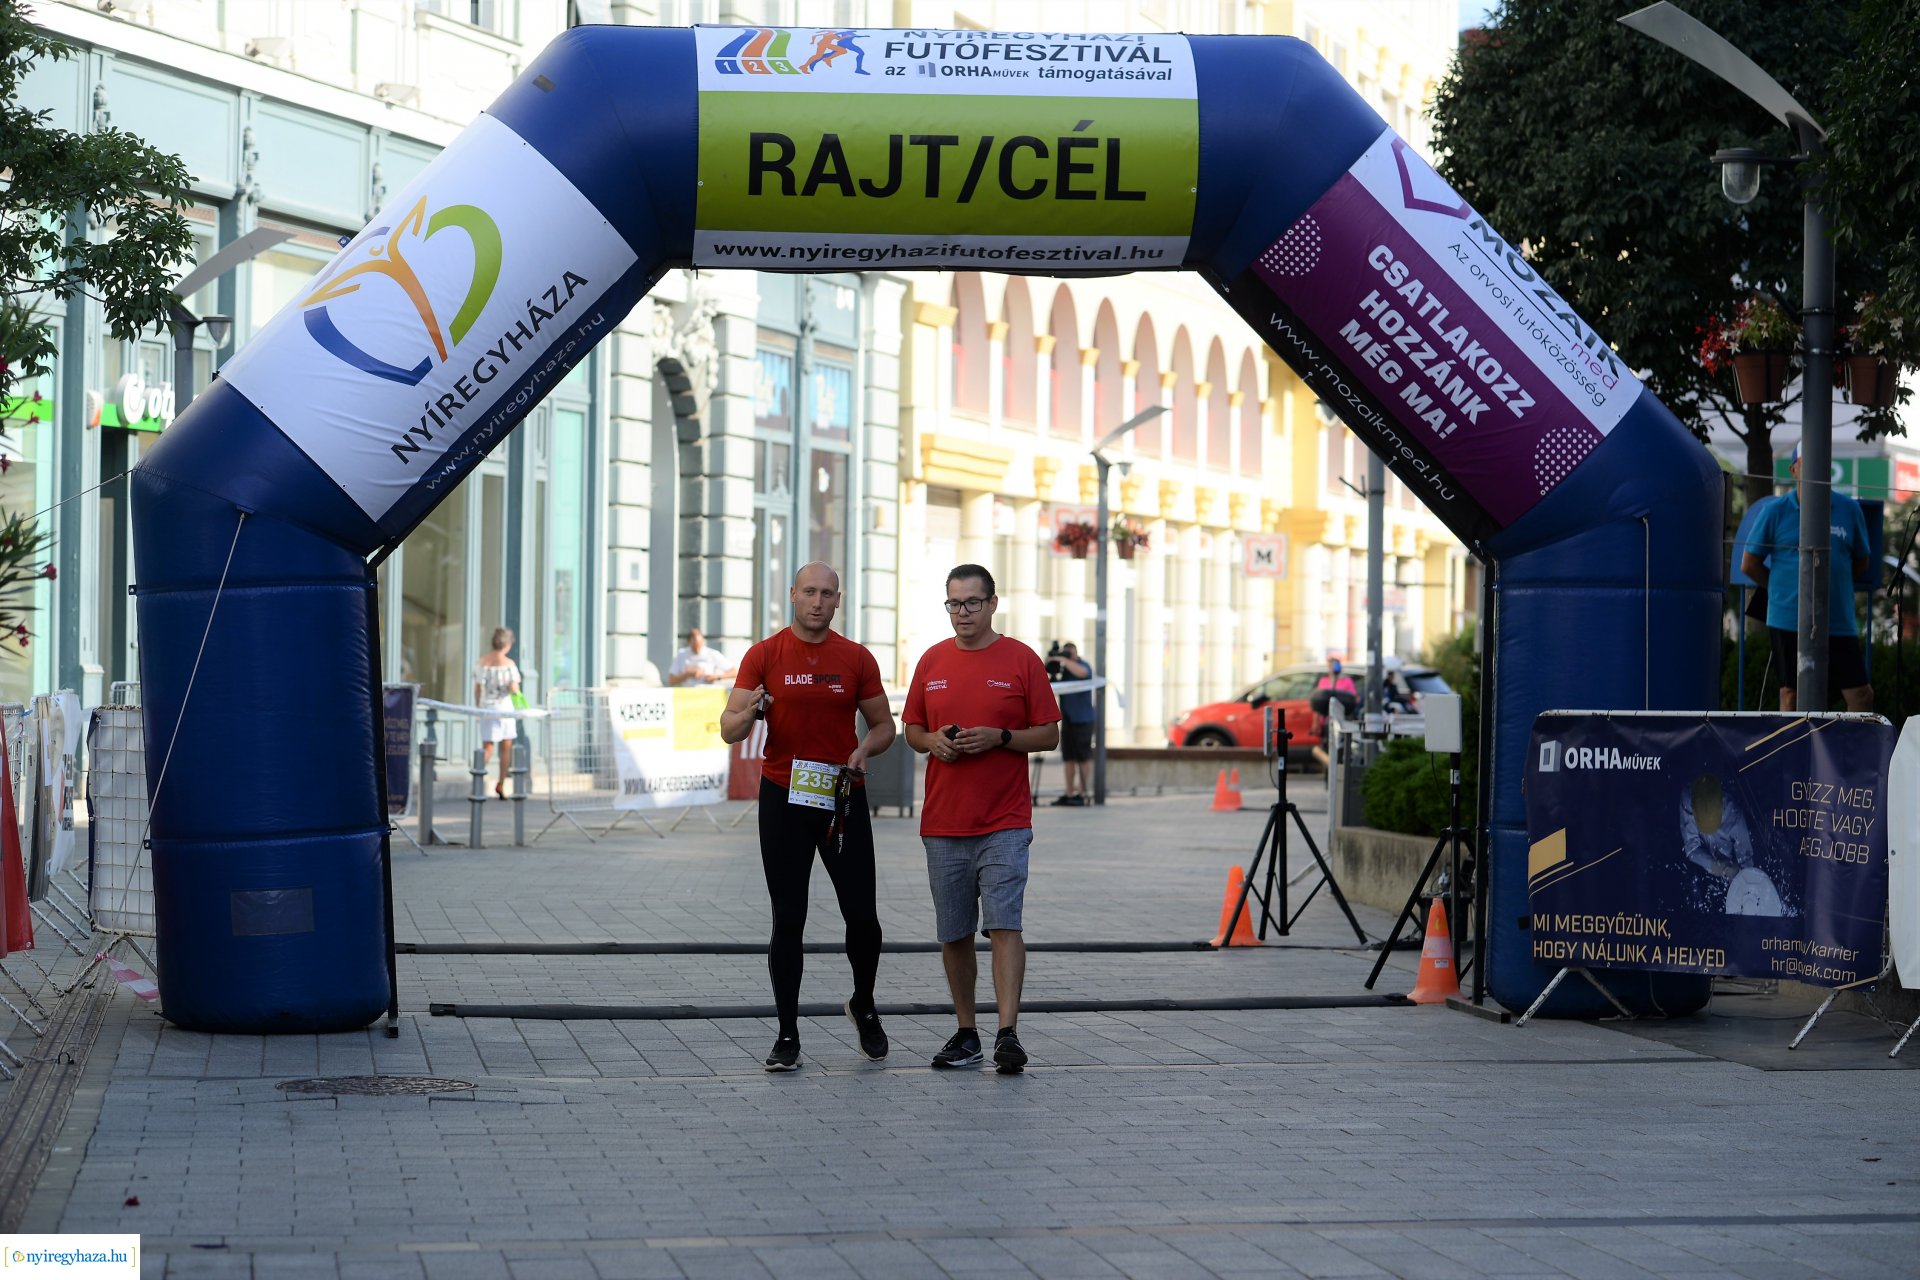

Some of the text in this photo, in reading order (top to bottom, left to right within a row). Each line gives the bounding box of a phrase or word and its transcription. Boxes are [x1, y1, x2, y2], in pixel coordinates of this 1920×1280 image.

[884, 39, 1172, 64] FUTÓFESZTIVÁL
[885, 66, 906, 76] az
[1038, 65, 1172, 83] támogatásával
[747, 119, 1147, 204] RAJT/CÉL
[713, 243, 1165, 263] www.nyiregyhazifutofesztival.hu
[1469, 219, 1624, 379] MOZAIK
[1368, 244, 1536, 419] CSATLAKOZZ
[1447, 243, 1607, 407] Az orvosi futóközösség
[390, 269, 589, 465] NYÍREGYHÁZA
[1338, 318, 1458, 440] MÉG MA!
[1358, 289, 1491, 426] HOZZÁNK
[1571, 342, 1619, 390] med
[425, 312, 606, 490] www.nyiregyhaza.hu
[1269, 312, 1455, 502] www.mozaikmed.hu
[1255, 549, 1273, 565] M
[797, 771, 837, 790] 235
[1837, 787, 1875, 812] MEG,
[1832, 813, 1875, 836] VAGY
[1533, 912, 1672, 940] MI MEGGYŐZÜNK,
[1533, 938, 1725, 968] HOGY NÁLUNK A HELYED
